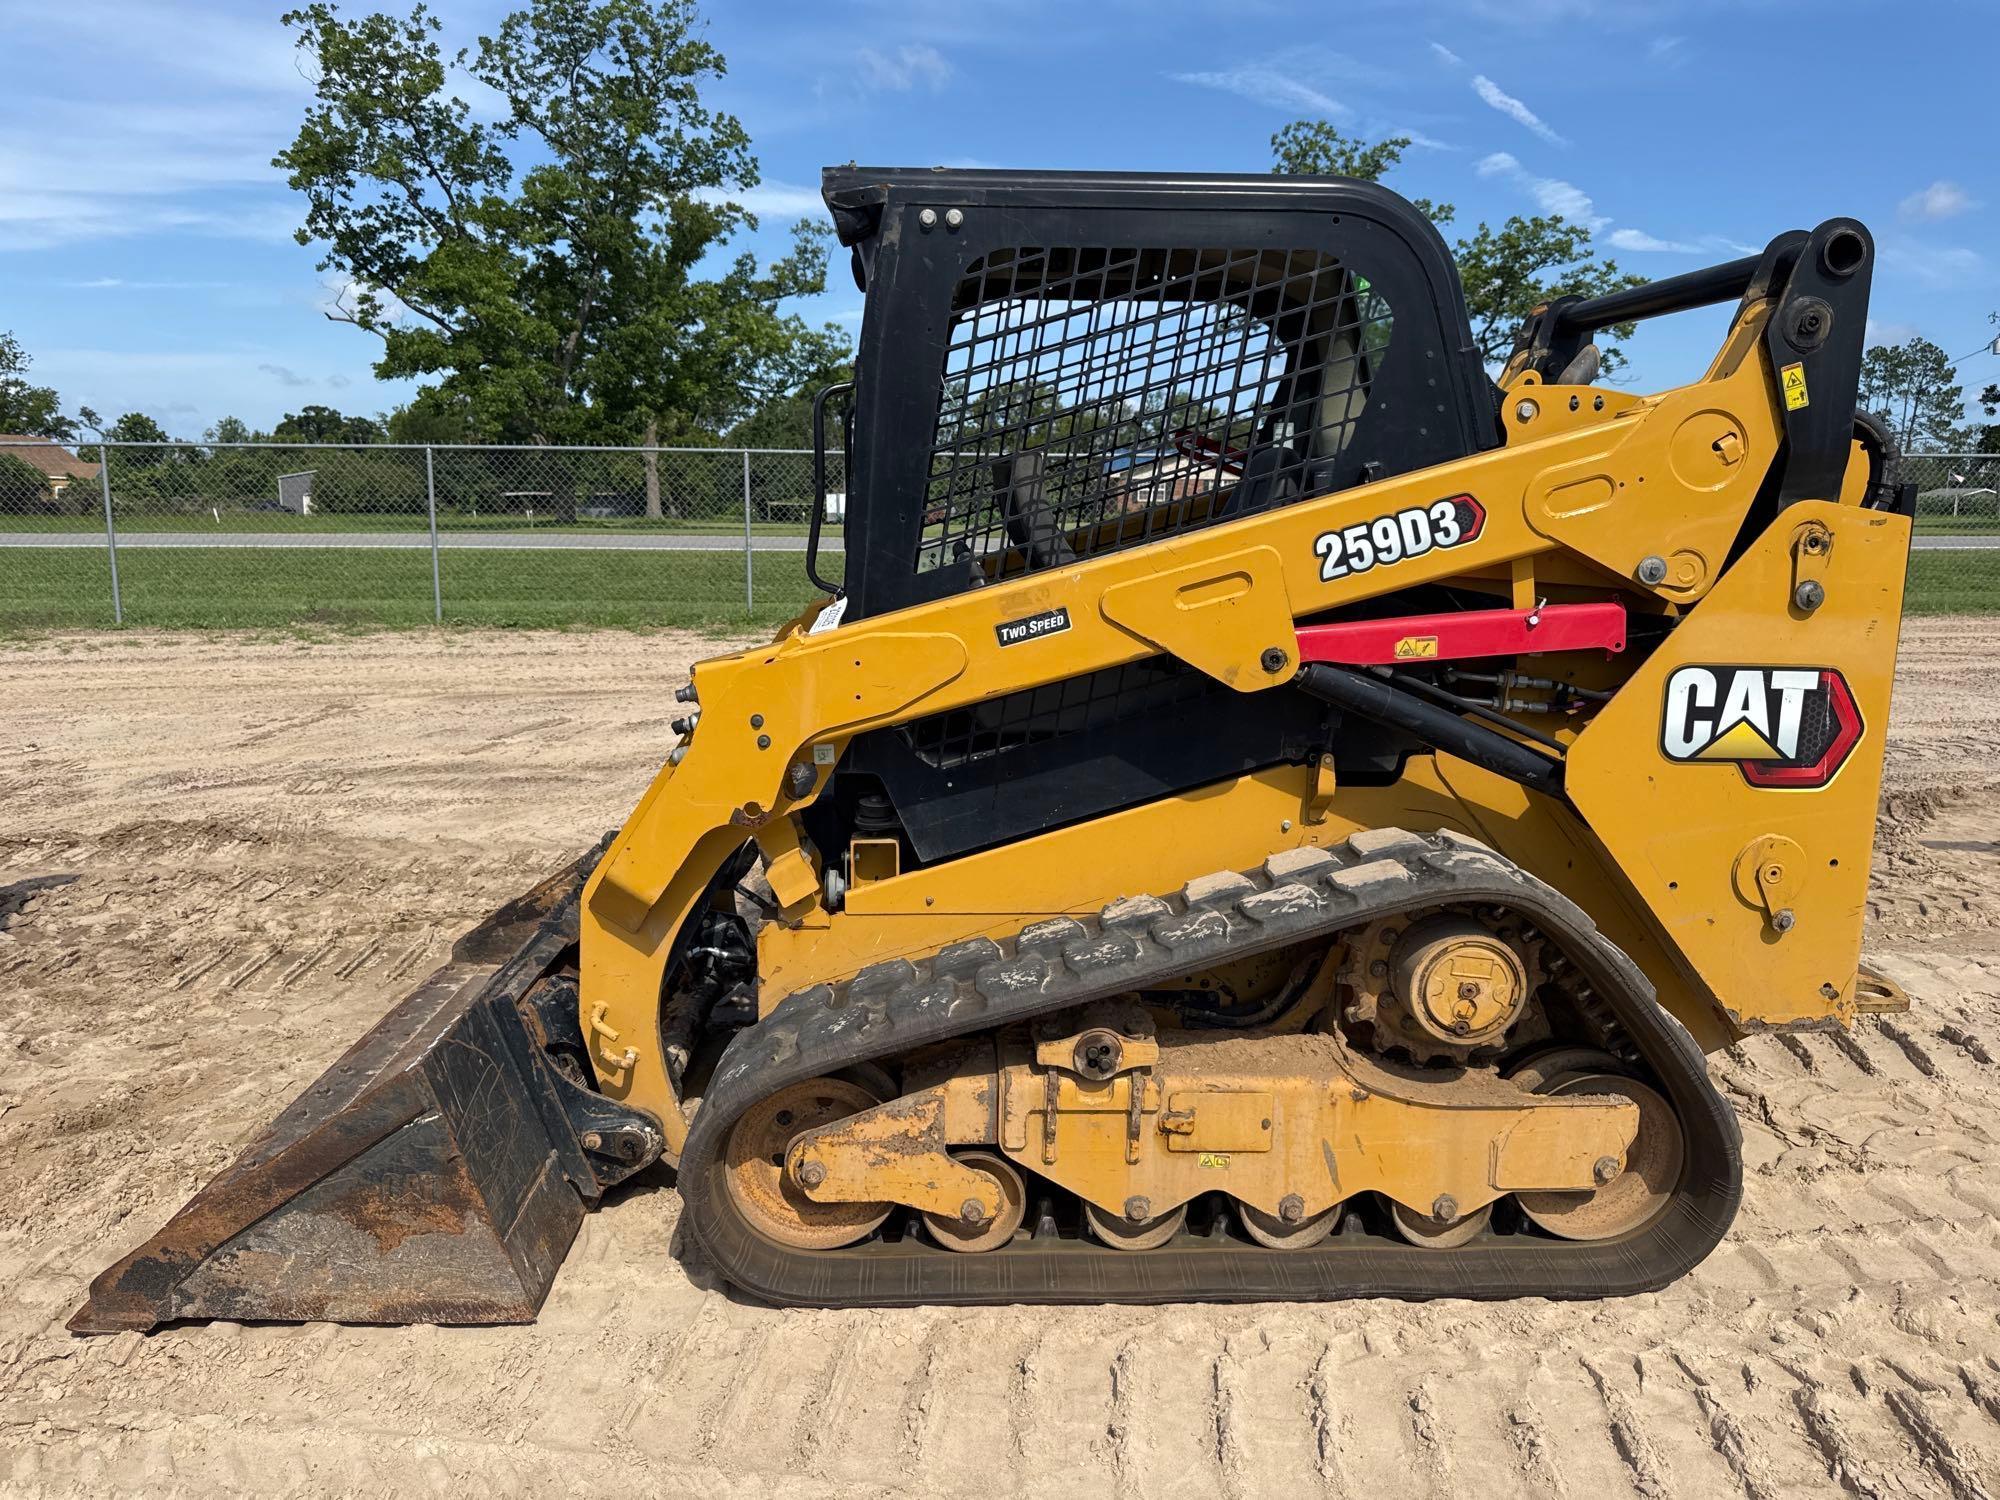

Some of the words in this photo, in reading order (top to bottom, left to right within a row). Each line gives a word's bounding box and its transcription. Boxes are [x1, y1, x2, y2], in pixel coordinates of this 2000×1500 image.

[1316, 501, 1461, 580] 259D3
[1001, 624, 1027, 641] TWO
[1029, 615, 1064, 634] SPEED
[1664, 667, 1820, 760] CAT
